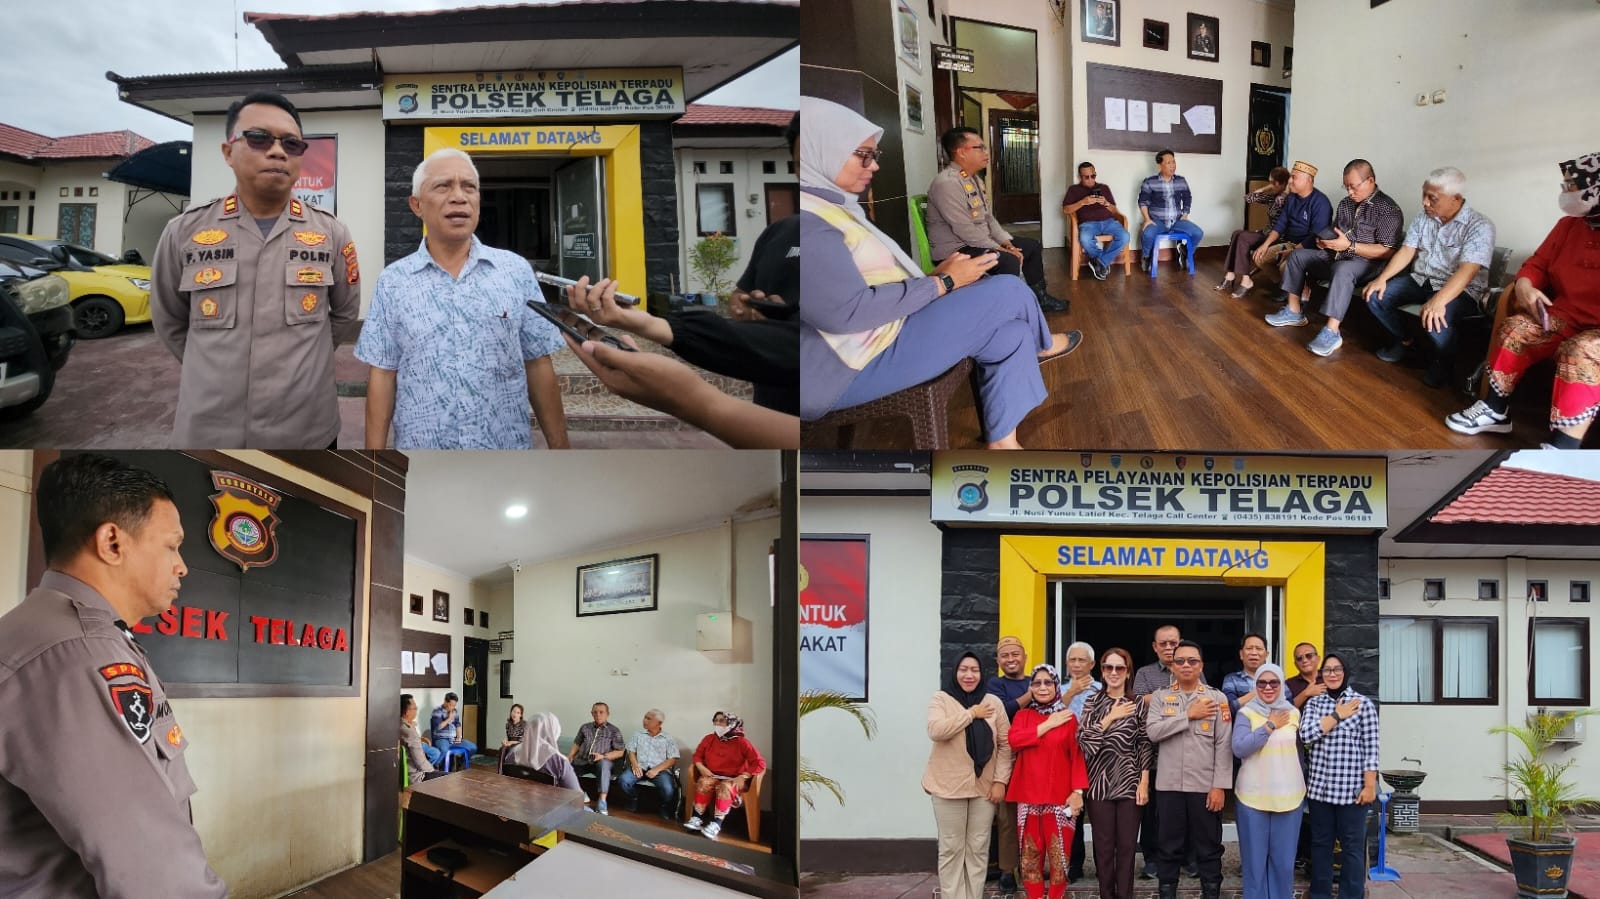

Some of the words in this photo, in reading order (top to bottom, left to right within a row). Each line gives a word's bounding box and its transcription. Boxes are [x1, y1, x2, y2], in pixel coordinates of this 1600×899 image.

[431, 84, 474, 93] SENTRA
[478, 81, 545, 93] PELAYANAN
[549, 80, 617, 90] KEPOLISIAN
[620, 79, 673, 89] TERPADU
[431, 91, 546, 110] POLSEK
[555, 89, 675, 107] TELAGA
[460, 132, 531, 146] SELAMAT
[536, 131, 602, 144] DATANG
[186, 255, 195, 264] F.
[199, 248, 234, 261] YASIN
[290, 250, 330, 262] POLRI
[1010, 469, 1078, 483] SENTRA
[1084, 470, 1185, 485] PELAYANAN
[1191, 473, 1290, 487] KEPOLISIAN
[1296, 475, 1373, 488] TERPADU
[1009, 485, 1185, 512] POLSEK
[1199, 489, 1373, 514] TELAGA
[1132, 512, 1163, 520] Telaga
[1345, 514, 1373, 522] 96181
[1057, 545, 1166, 566] SELAMAT
[1175, 547, 1269, 569] DATANG
[250, 616, 349, 651] TELAGA
[800, 636, 847, 652] AKAT
